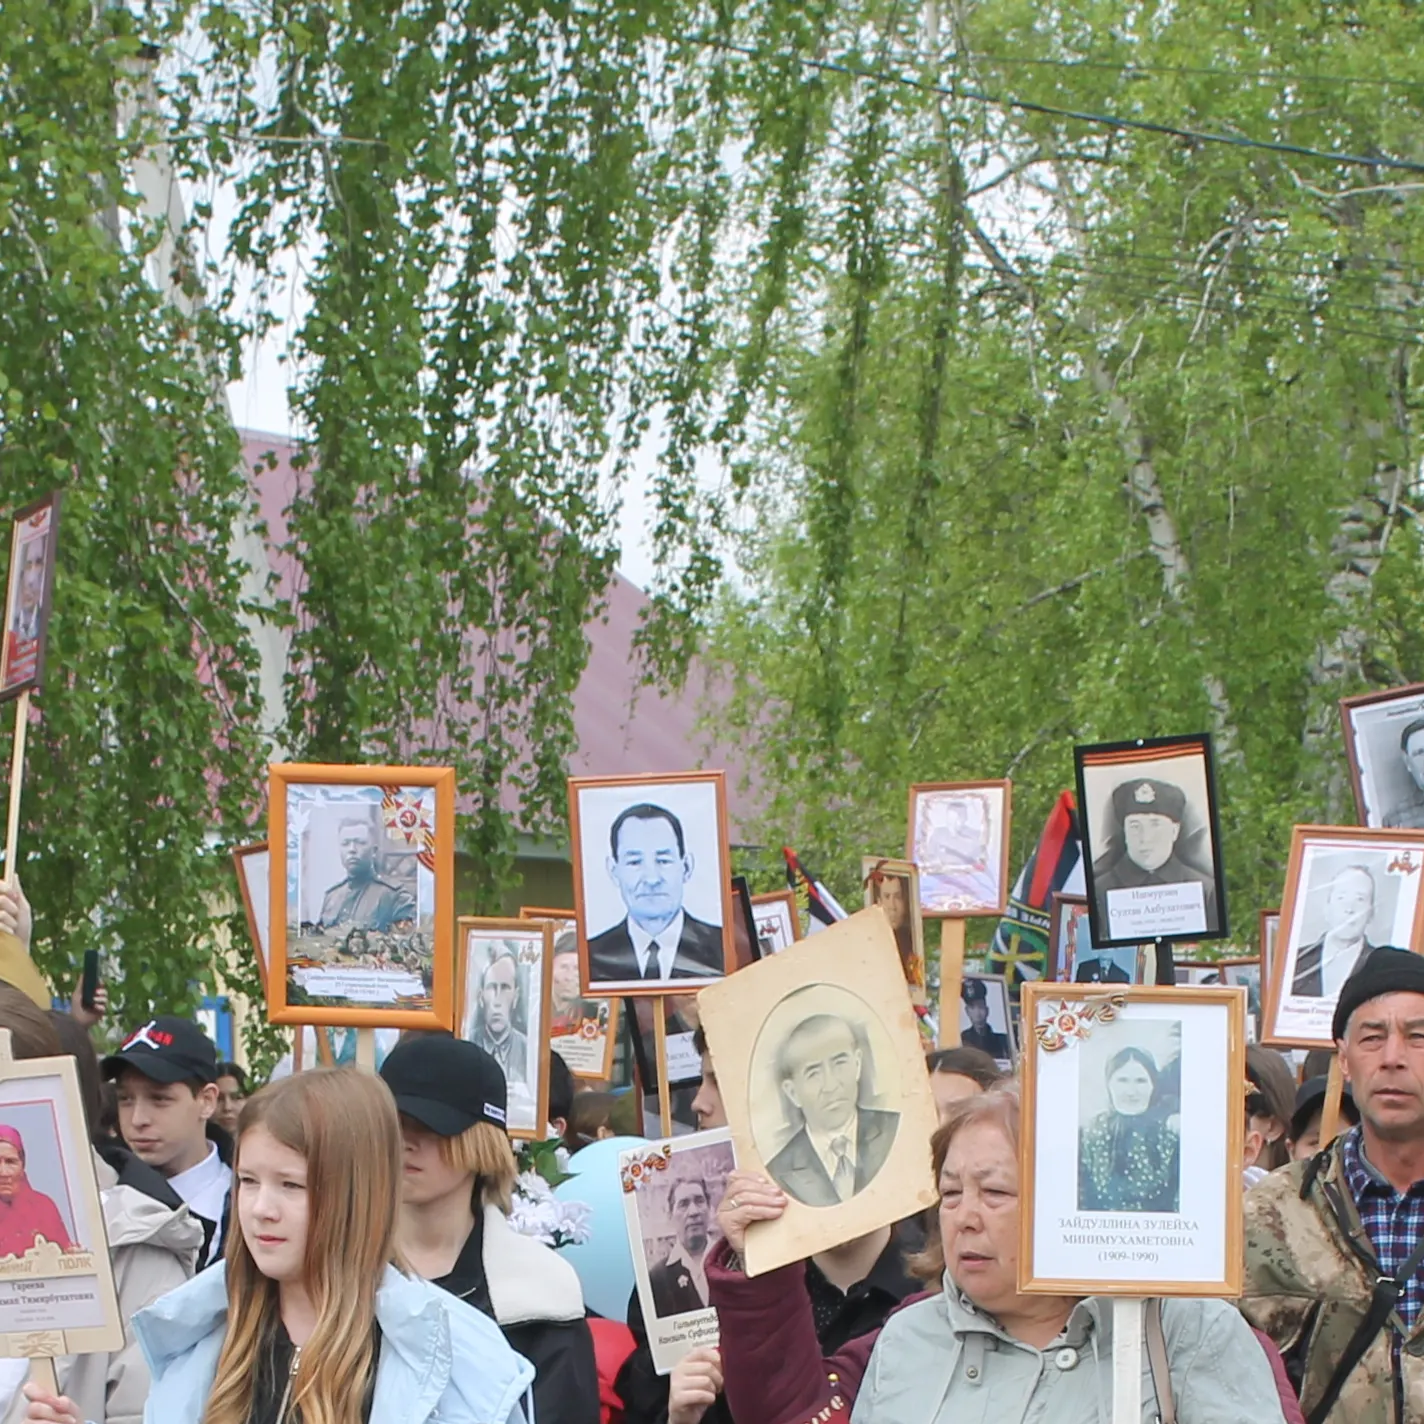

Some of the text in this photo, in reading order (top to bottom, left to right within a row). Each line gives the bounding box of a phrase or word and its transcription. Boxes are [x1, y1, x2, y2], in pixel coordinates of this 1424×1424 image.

[1058, 1216, 1200, 1232] ЗАЙДУЛЛИНА ЗУЛЕЙХА
[1062, 1233, 1195, 1248] МИНИМУХАМЕТОВНА
[1097, 1250, 1160, 1264] (1909-1990)
